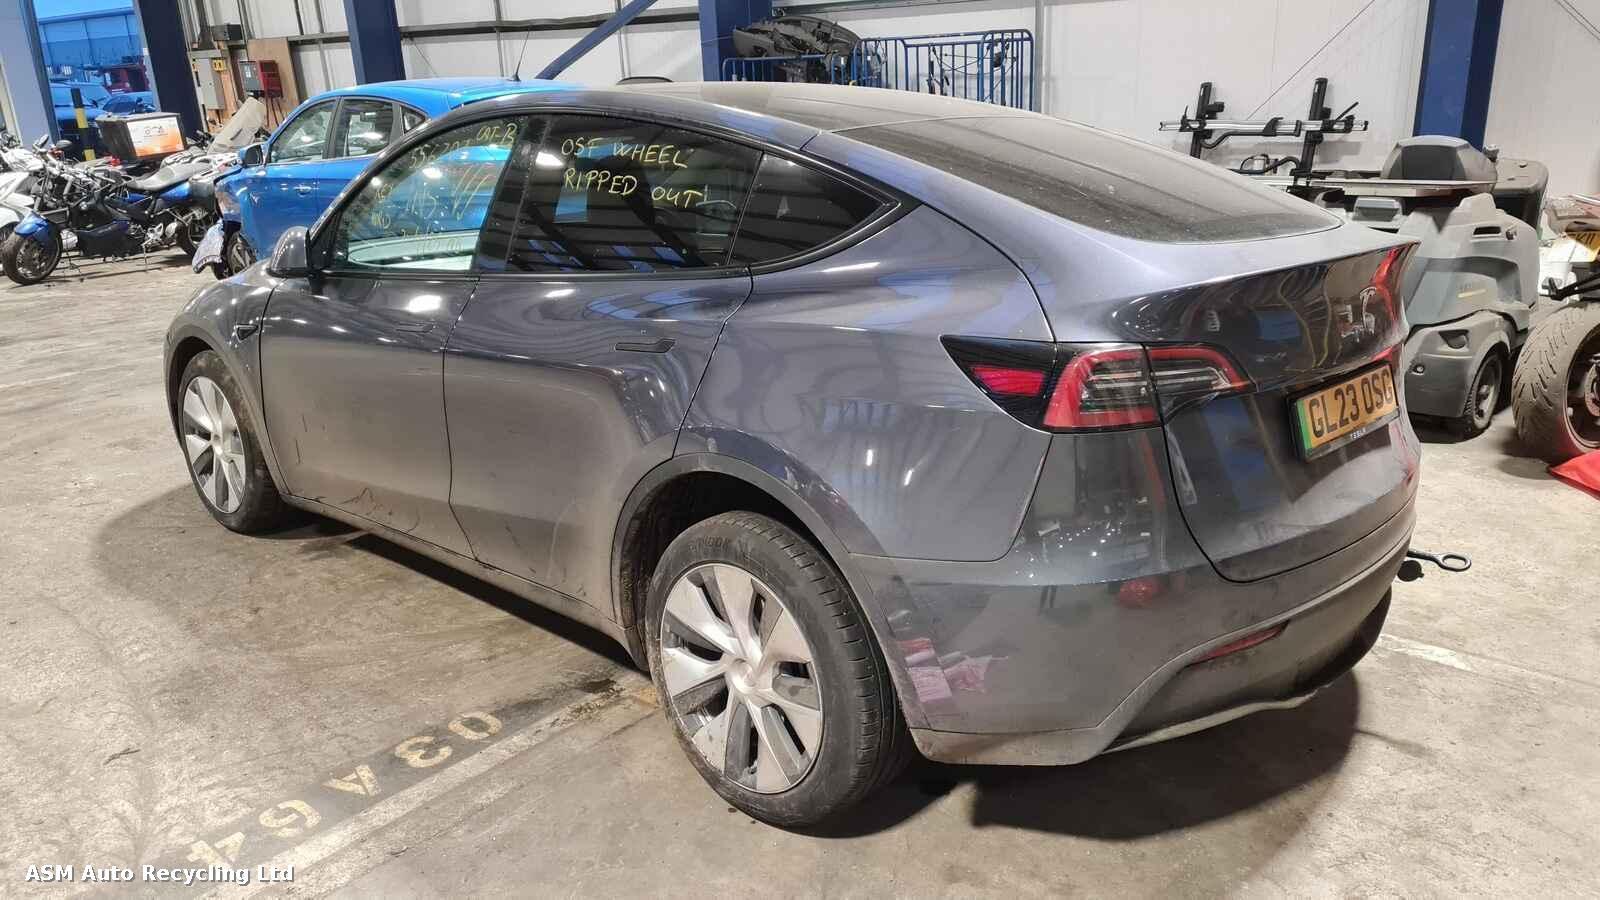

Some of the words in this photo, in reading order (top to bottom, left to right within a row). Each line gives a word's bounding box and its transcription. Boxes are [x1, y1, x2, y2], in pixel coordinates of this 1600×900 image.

[561, 137, 604, 157] OSF
[612, 142, 688, 168] WHEEL
[564, 168, 638, 195] RIPPED
[1309, 383, 1360, 438] GL23
[1361, 369, 1393, 415] OSG
